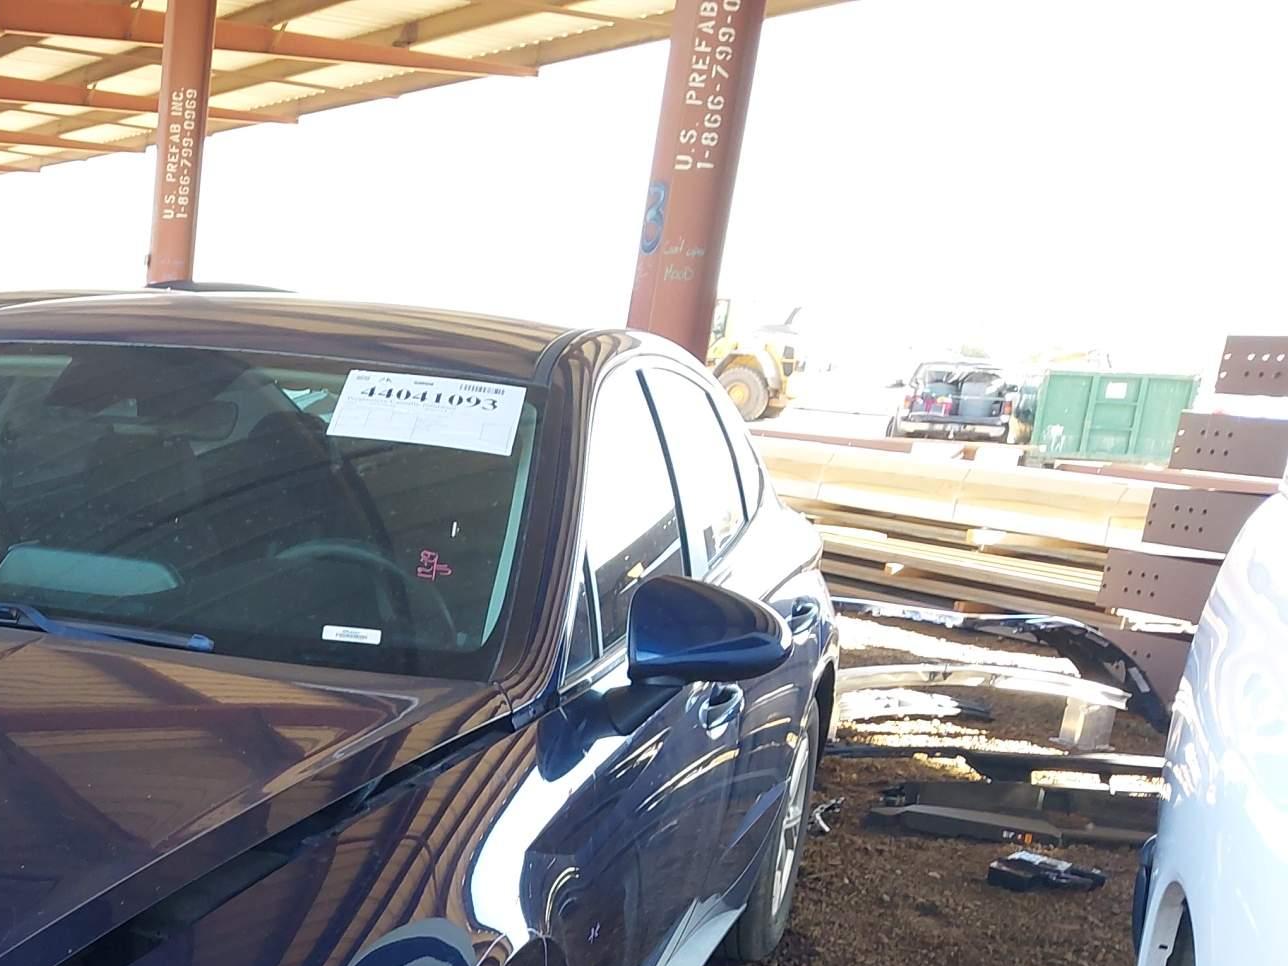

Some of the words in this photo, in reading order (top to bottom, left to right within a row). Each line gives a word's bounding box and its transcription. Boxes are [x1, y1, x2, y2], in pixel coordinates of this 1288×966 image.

[685, 1, 718, 105] PREFAB
[171, 87, 185, 116] INC.
[166, 123, 182, 182] PREFAB
[175, 88, 197, 219] 1-866-799-0969
[674, 122, 699, 170] U.S.
[163, 190, 177, 220] U.S.
[360, 386, 498, 411] 44041093
